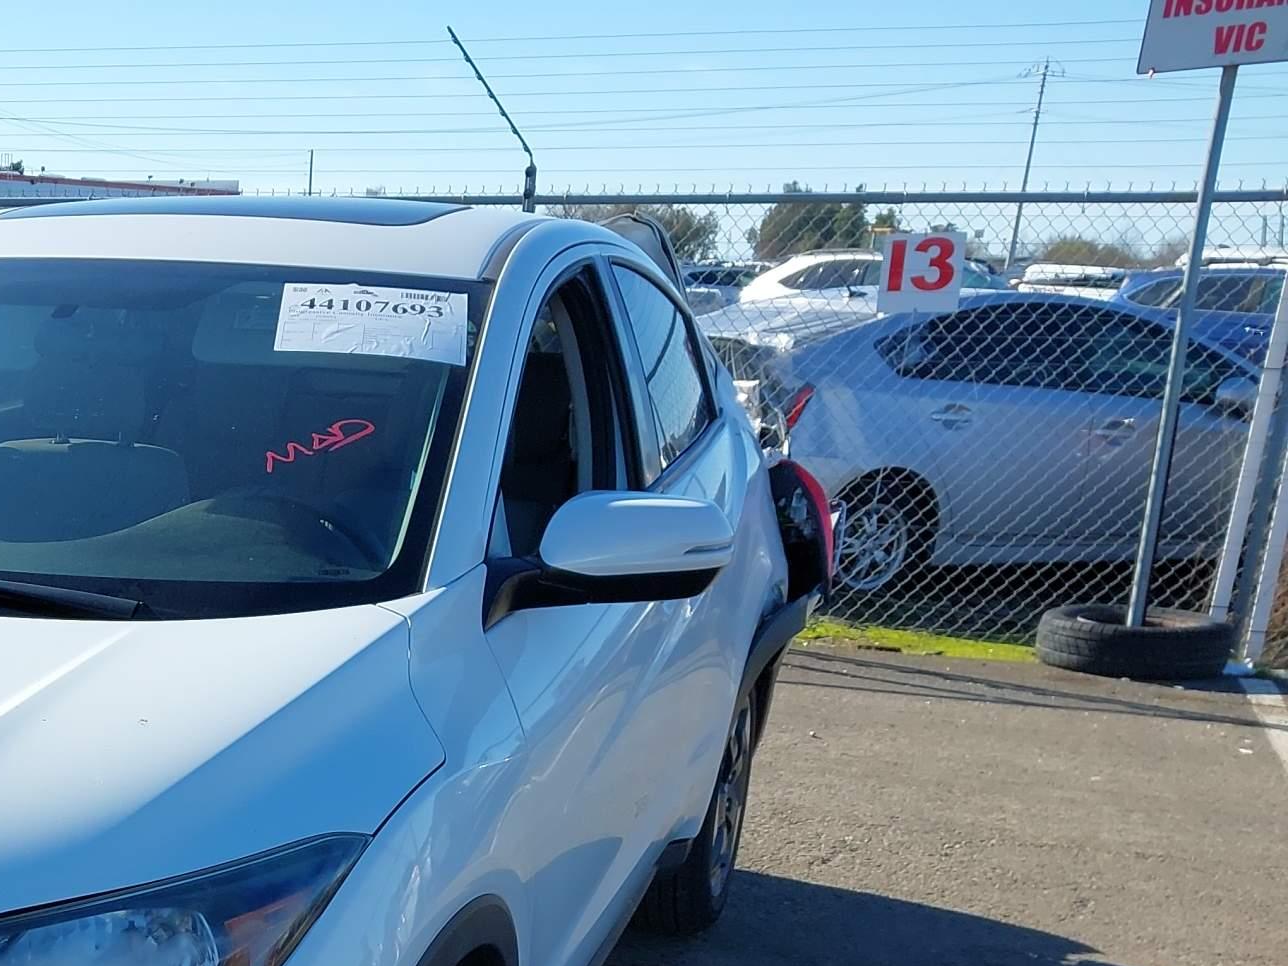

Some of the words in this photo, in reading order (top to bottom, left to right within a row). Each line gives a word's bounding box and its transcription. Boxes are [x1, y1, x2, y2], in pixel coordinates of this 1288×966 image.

[1162, 0, 1288, 18] INSU
[1214, 22, 1267, 55] VIC
[887, 236, 955, 291] 13
[300, 297, 444, 318] 44107693
